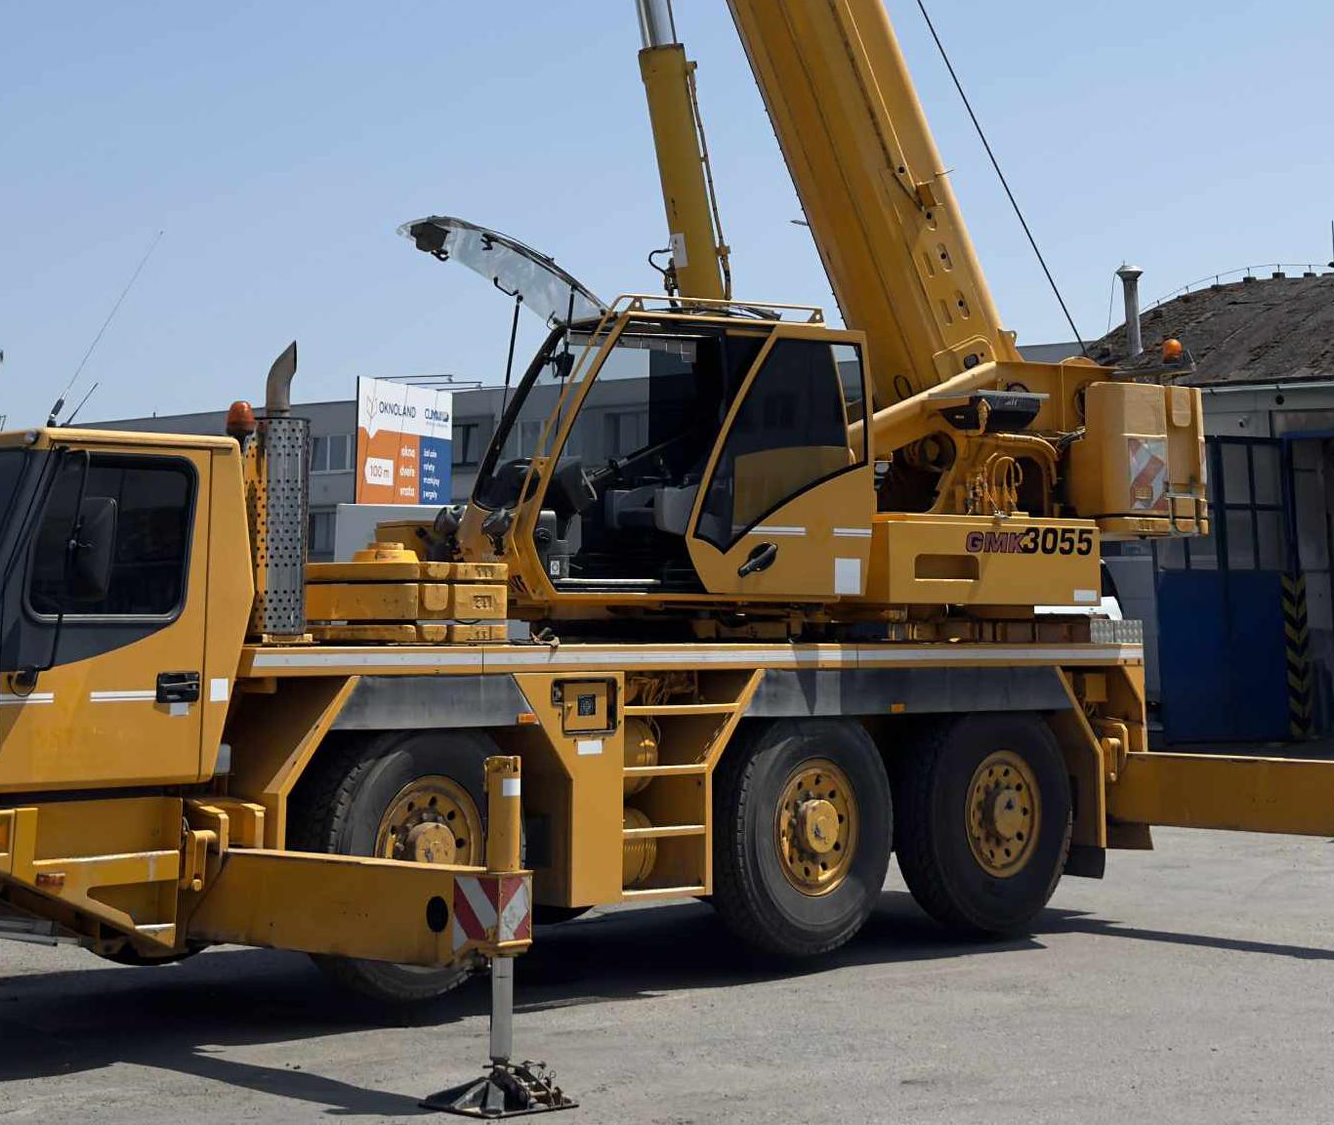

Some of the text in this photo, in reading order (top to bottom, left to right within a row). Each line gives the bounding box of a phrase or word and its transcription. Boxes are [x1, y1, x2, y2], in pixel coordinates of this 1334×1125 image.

[379, 401, 416, 418] OKNOLAND
[370, 464, 390, 477] 100 m
